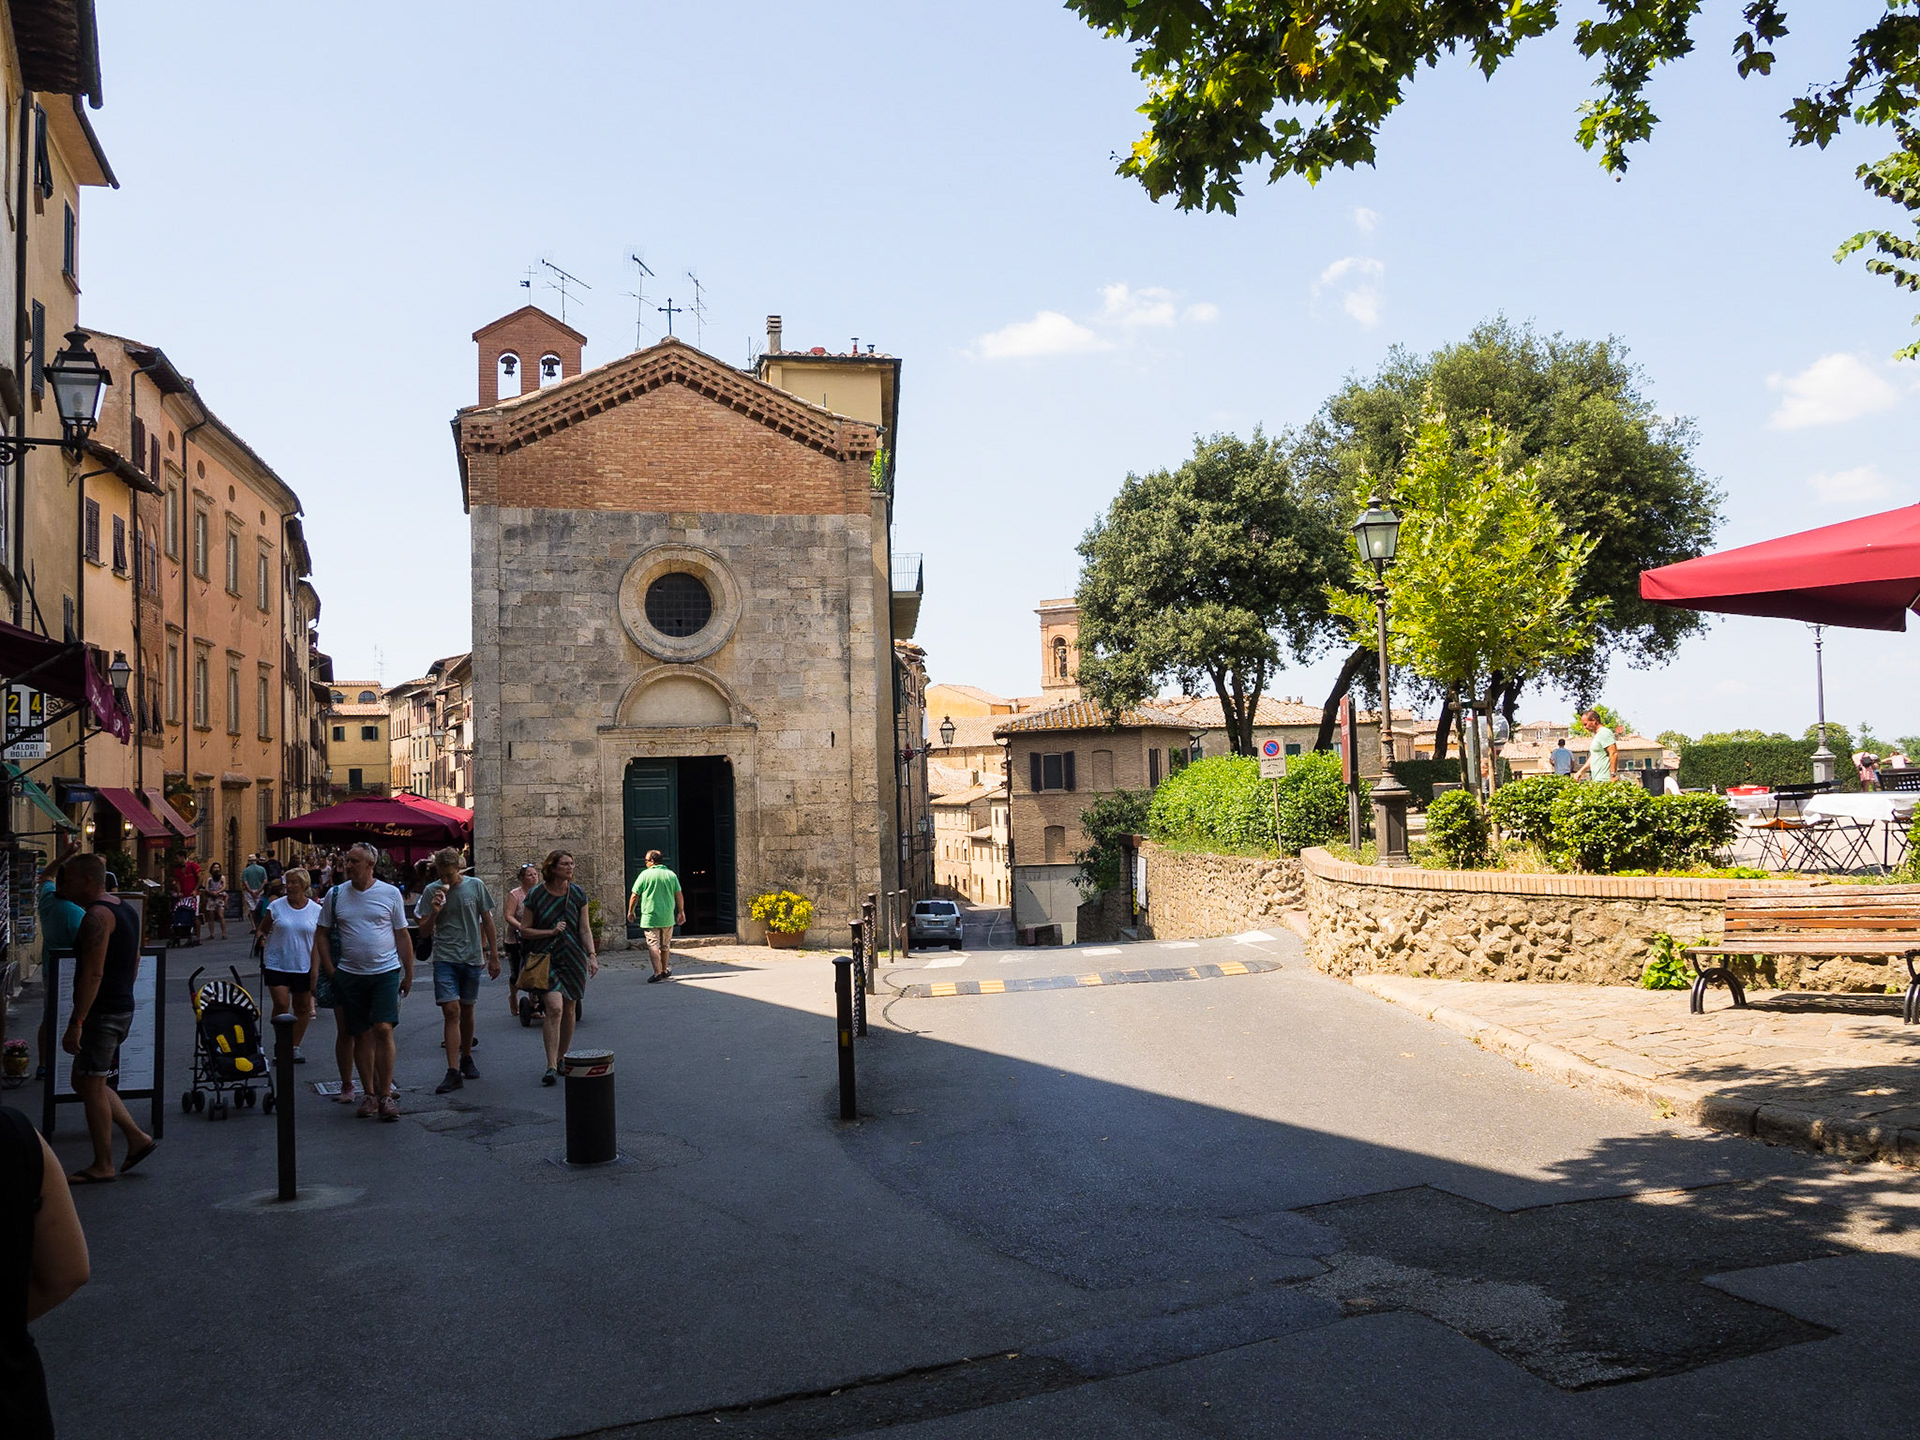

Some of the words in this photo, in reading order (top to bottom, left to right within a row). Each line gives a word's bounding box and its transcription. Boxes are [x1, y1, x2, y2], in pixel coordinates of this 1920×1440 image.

[7, 733, 43, 741] TACHI
[12, 743, 39, 751] VALORI
[10, 750, 40, 758] BOLLATI
[383, 822, 413, 837] Sera
